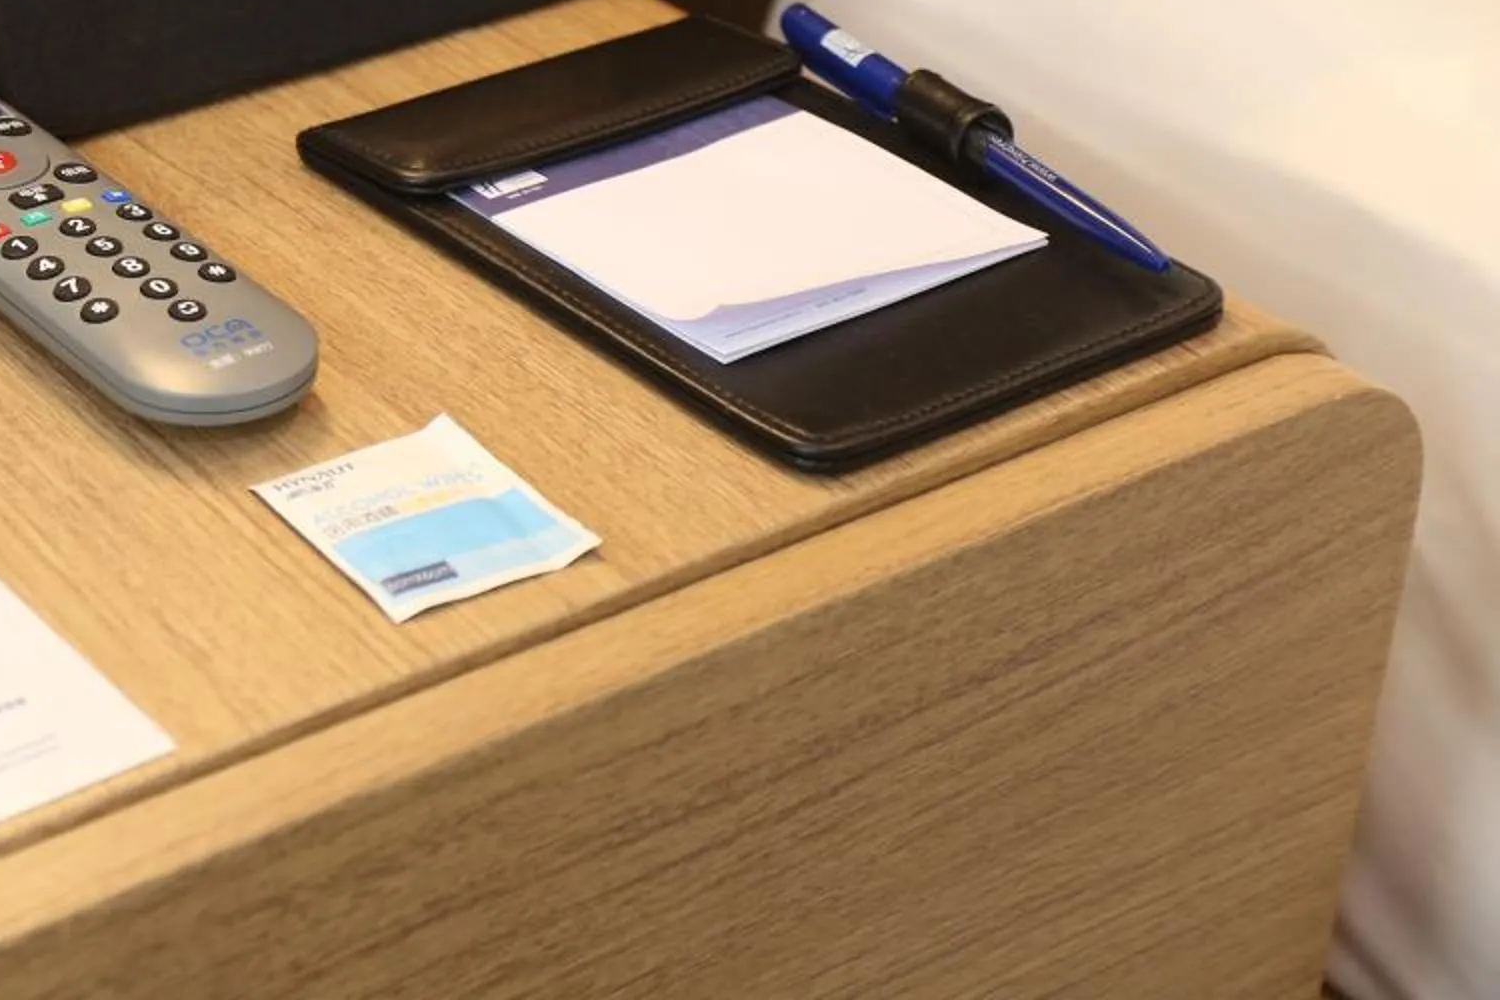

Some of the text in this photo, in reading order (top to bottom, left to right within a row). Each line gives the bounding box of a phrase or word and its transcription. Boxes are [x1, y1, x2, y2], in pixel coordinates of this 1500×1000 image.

[125, 203, 146, 217] 3
[68, 219, 90, 232] 2
[151, 223, 172, 235] 6
[11, 239, 28, 250] 1
[94, 239, 114, 251] 5
[179, 244, 199, 256] 9
[39, 258, 56, 271] 4
[120, 258, 143, 272] 8
[60, 278, 77, 295] 7
[149, 279, 170, 292] 0
